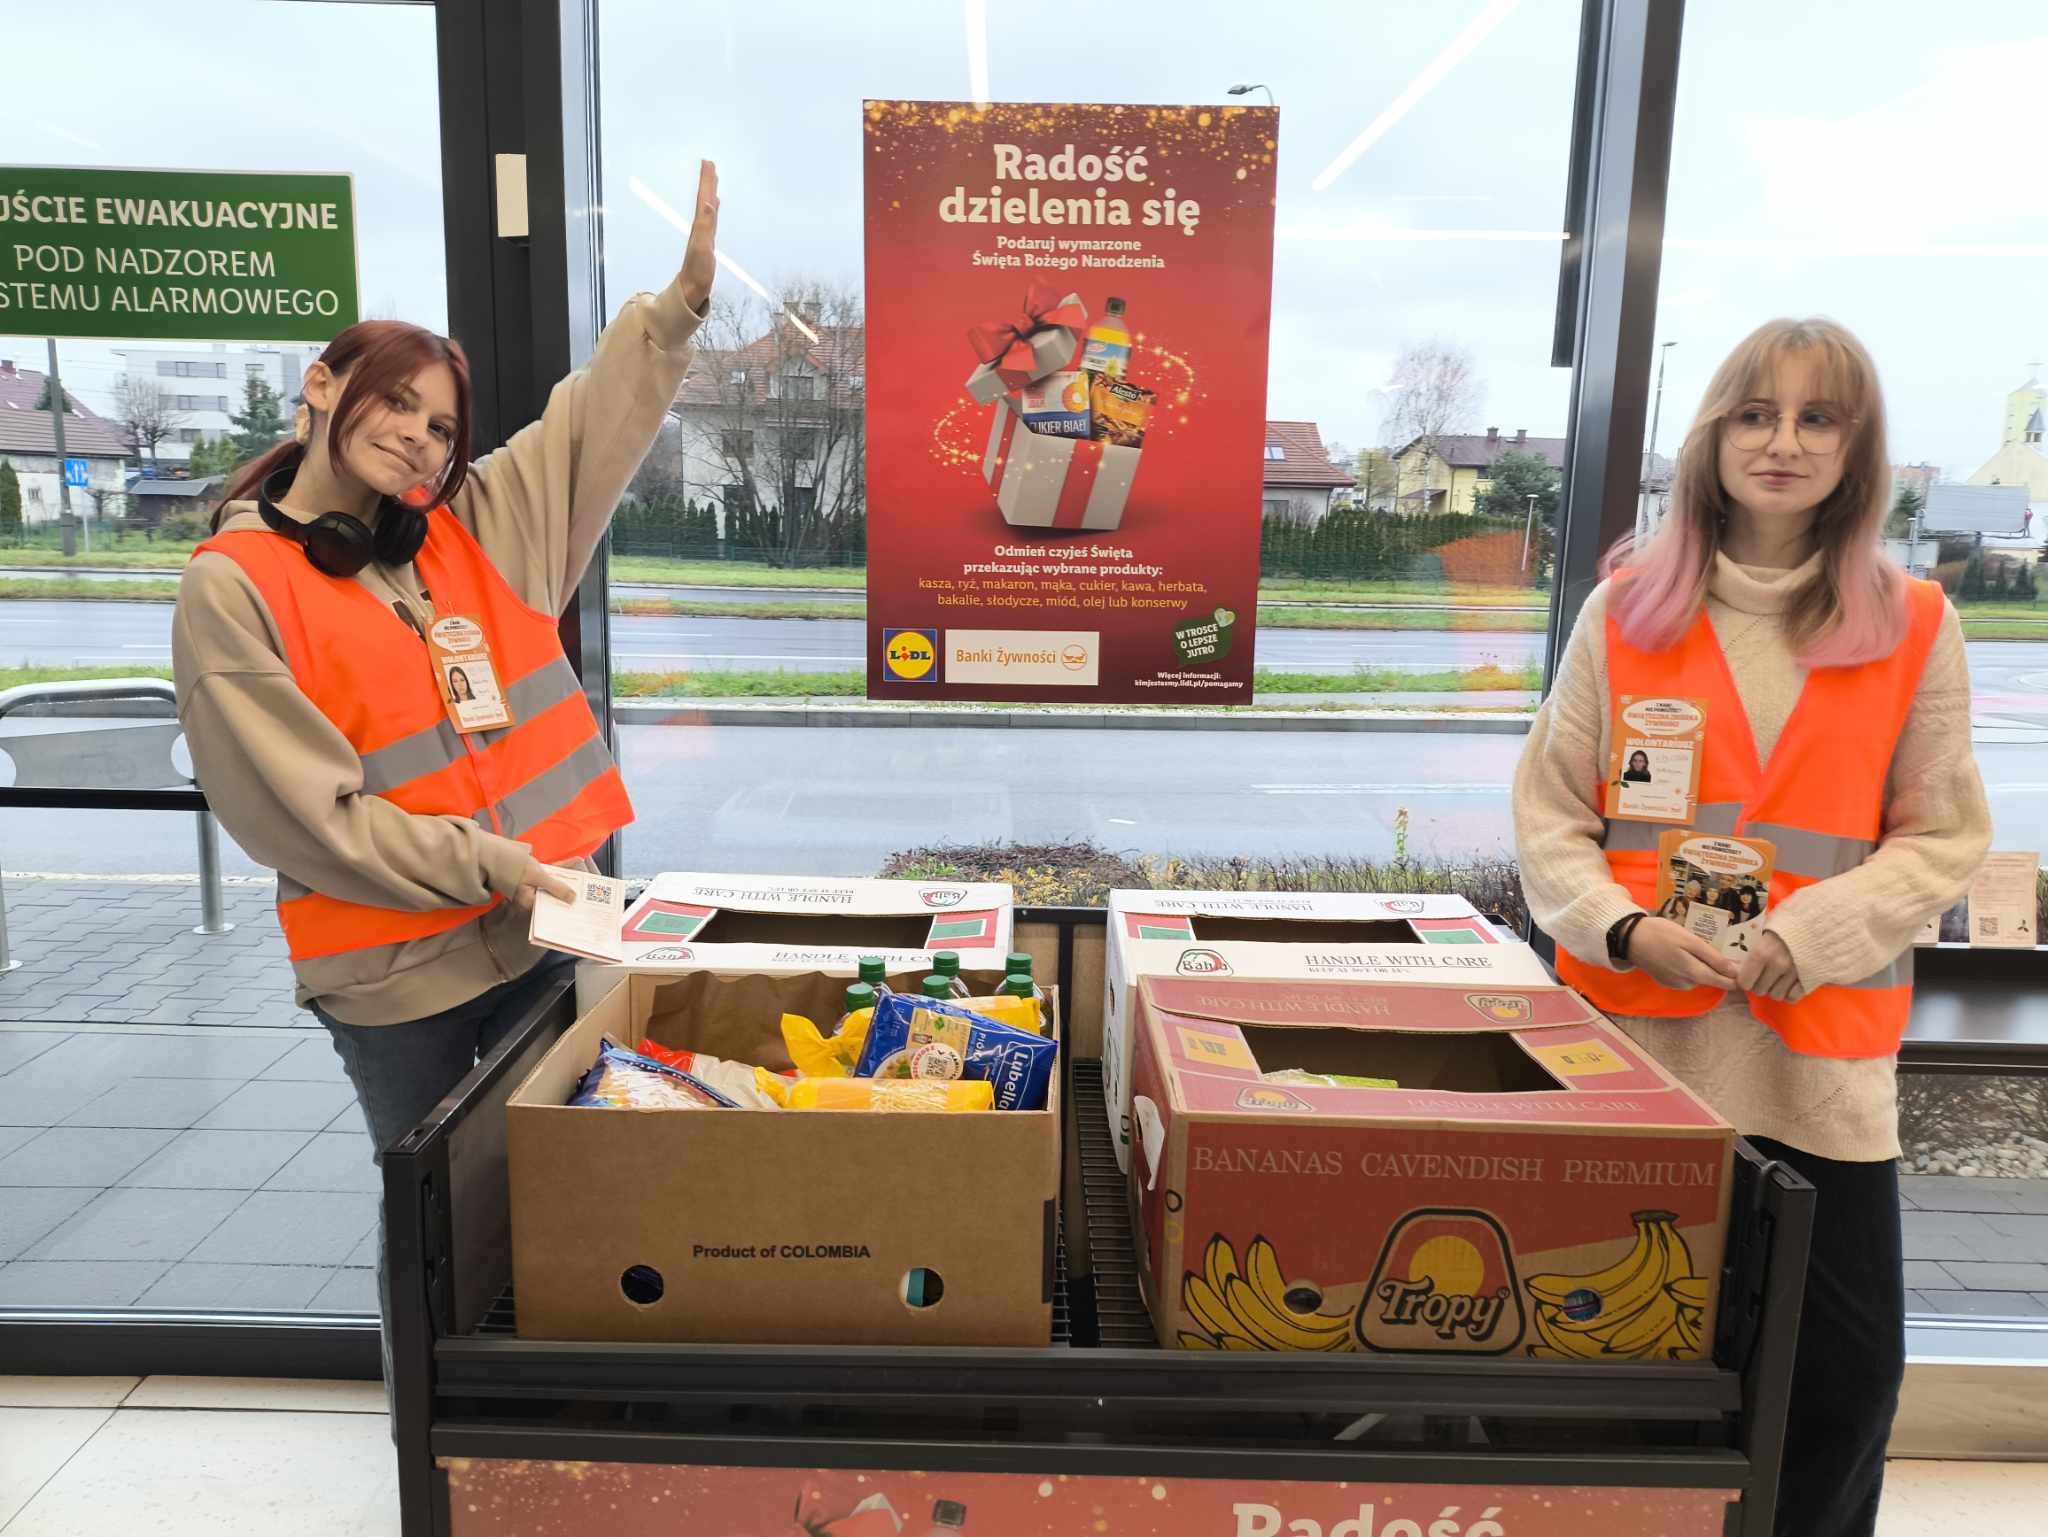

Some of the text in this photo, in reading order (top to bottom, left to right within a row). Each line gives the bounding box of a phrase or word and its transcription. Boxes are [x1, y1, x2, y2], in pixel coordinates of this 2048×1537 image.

[994, 144, 1148, 182] Radość
[96, 197, 338, 230] EWAKUACYJNE
[938, 186, 1200, 236] dzielenia się
[996, 236, 1141, 253] Podaruj wymarzone
[14, 245, 275, 277] POD NADZOREM
[973, 253, 1165, 271] Święta Bożego Narodzenia
[112, 286, 338, 316] ALARMOWEGO
[994, 545, 1133, 560] Odmień czyjeś Święta
[963, 561, 1163, 577] przekazując wybrane produkty:
[919, 578, 1207, 594] kasza, ryż, makaron, mąka, cukier, kawa, herbata,
[937, 594, 1188, 611] bakalie, słodycze, miód, olej lub konserwy
[1175, 630, 1185, 640] W
[1180, 633, 1219, 650] O LEPSZE
[956, 646, 1057, 668] Banki Żywności
[1185, 645, 1216, 659] JUTRO
[1157, 672, 1182, 681] Więcej
[694, 886, 735, 898] CARE
[740, 890, 784, 901] WITH
[787, 892, 853, 904] HANDLE
[1304, 954, 1494, 969] HANDLE WITH CARE
[997, 1050, 1030, 1110] Lubella
[1193, 1147, 1715, 1186] BANANAS CAVENDISH PREMIUM
[693, 1243, 871, 1259] Product of COLOMBIA
[1377, 1274, 1505, 1342] Tropy
